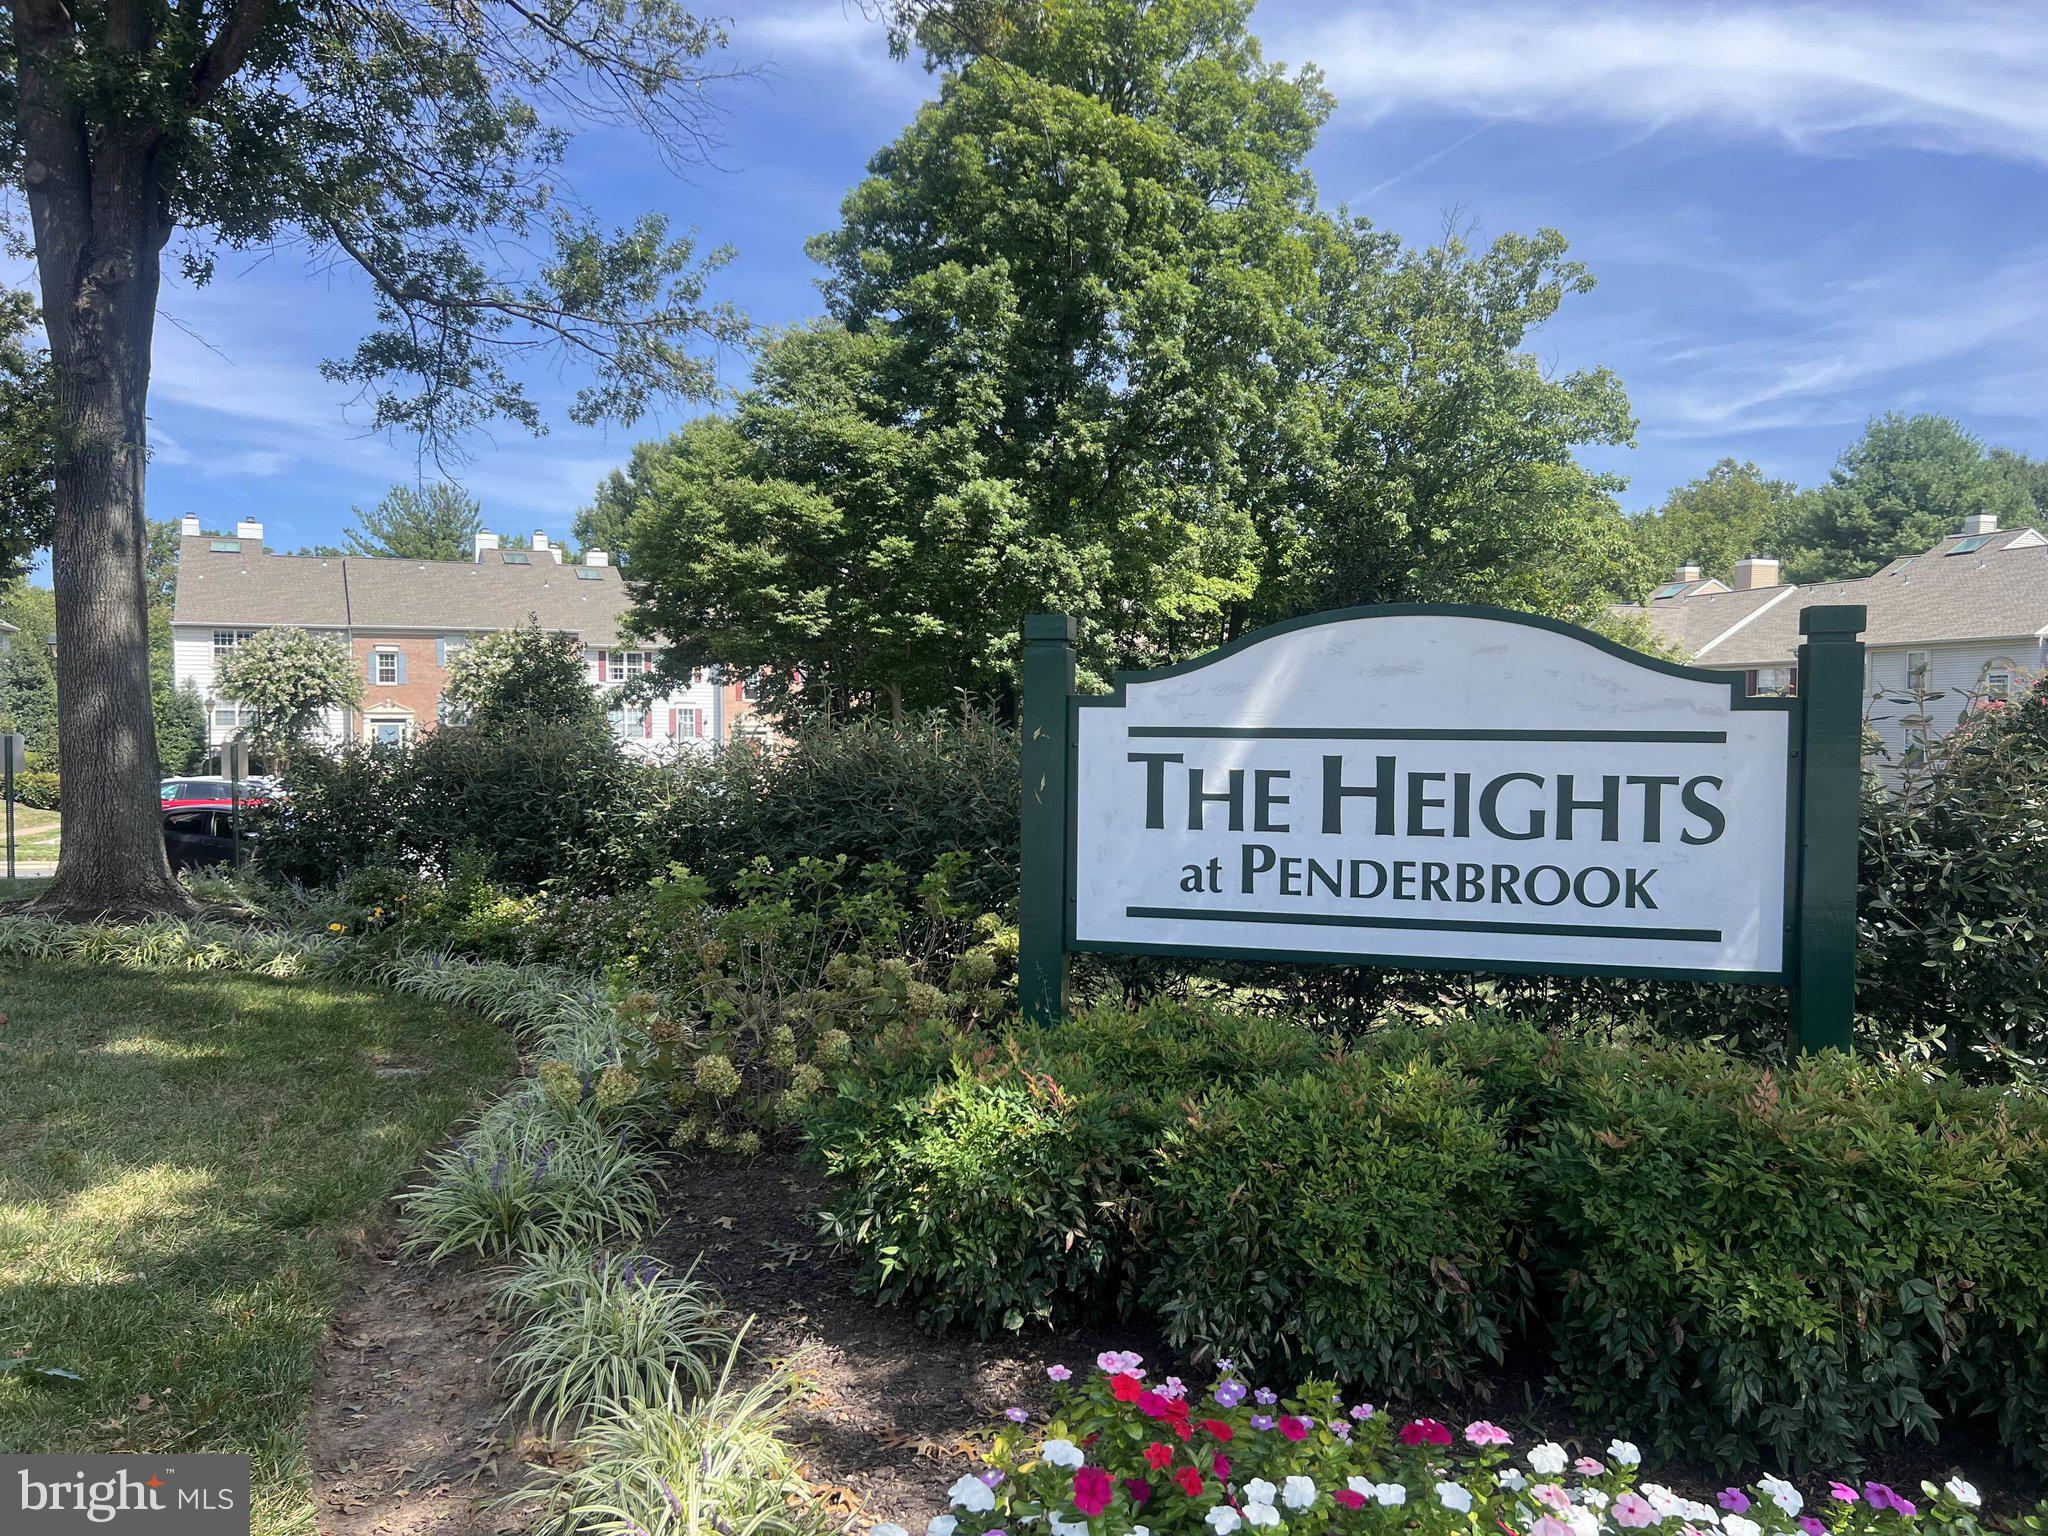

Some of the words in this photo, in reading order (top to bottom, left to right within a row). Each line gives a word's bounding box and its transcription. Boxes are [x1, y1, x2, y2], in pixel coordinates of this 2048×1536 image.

[1127, 752, 1291, 833] THE
[1321, 754, 1726, 846] HEIGHTS
[1179, 856, 1223, 894] at
[1241, 843, 1659, 910] PENDERBROOK
